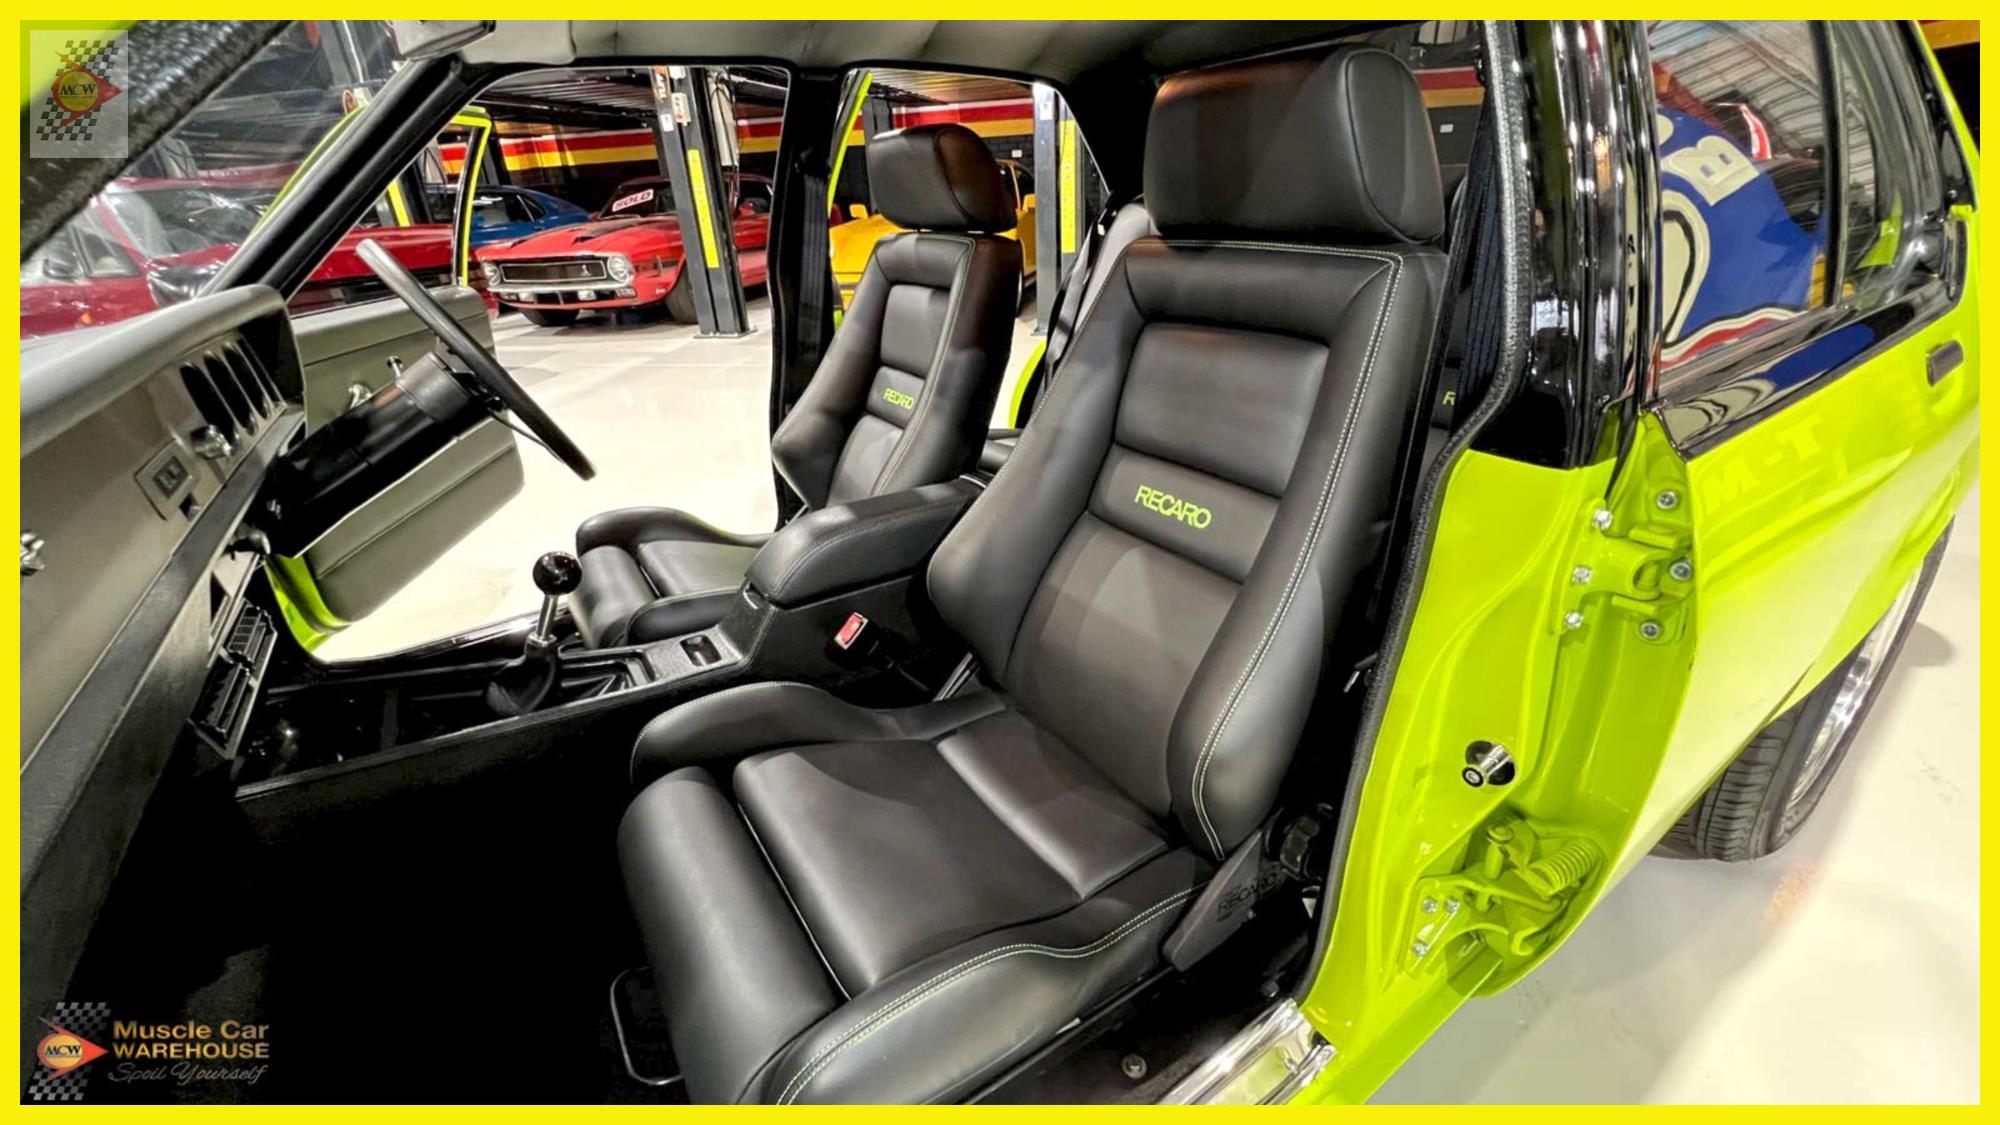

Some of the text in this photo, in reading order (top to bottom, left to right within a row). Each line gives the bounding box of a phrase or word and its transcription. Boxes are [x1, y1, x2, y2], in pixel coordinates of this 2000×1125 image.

[614, 191, 651, 210] SOLD
[883, 387, 914, 410] RECARO
[1134, 485, 1212, 529] RECARO
